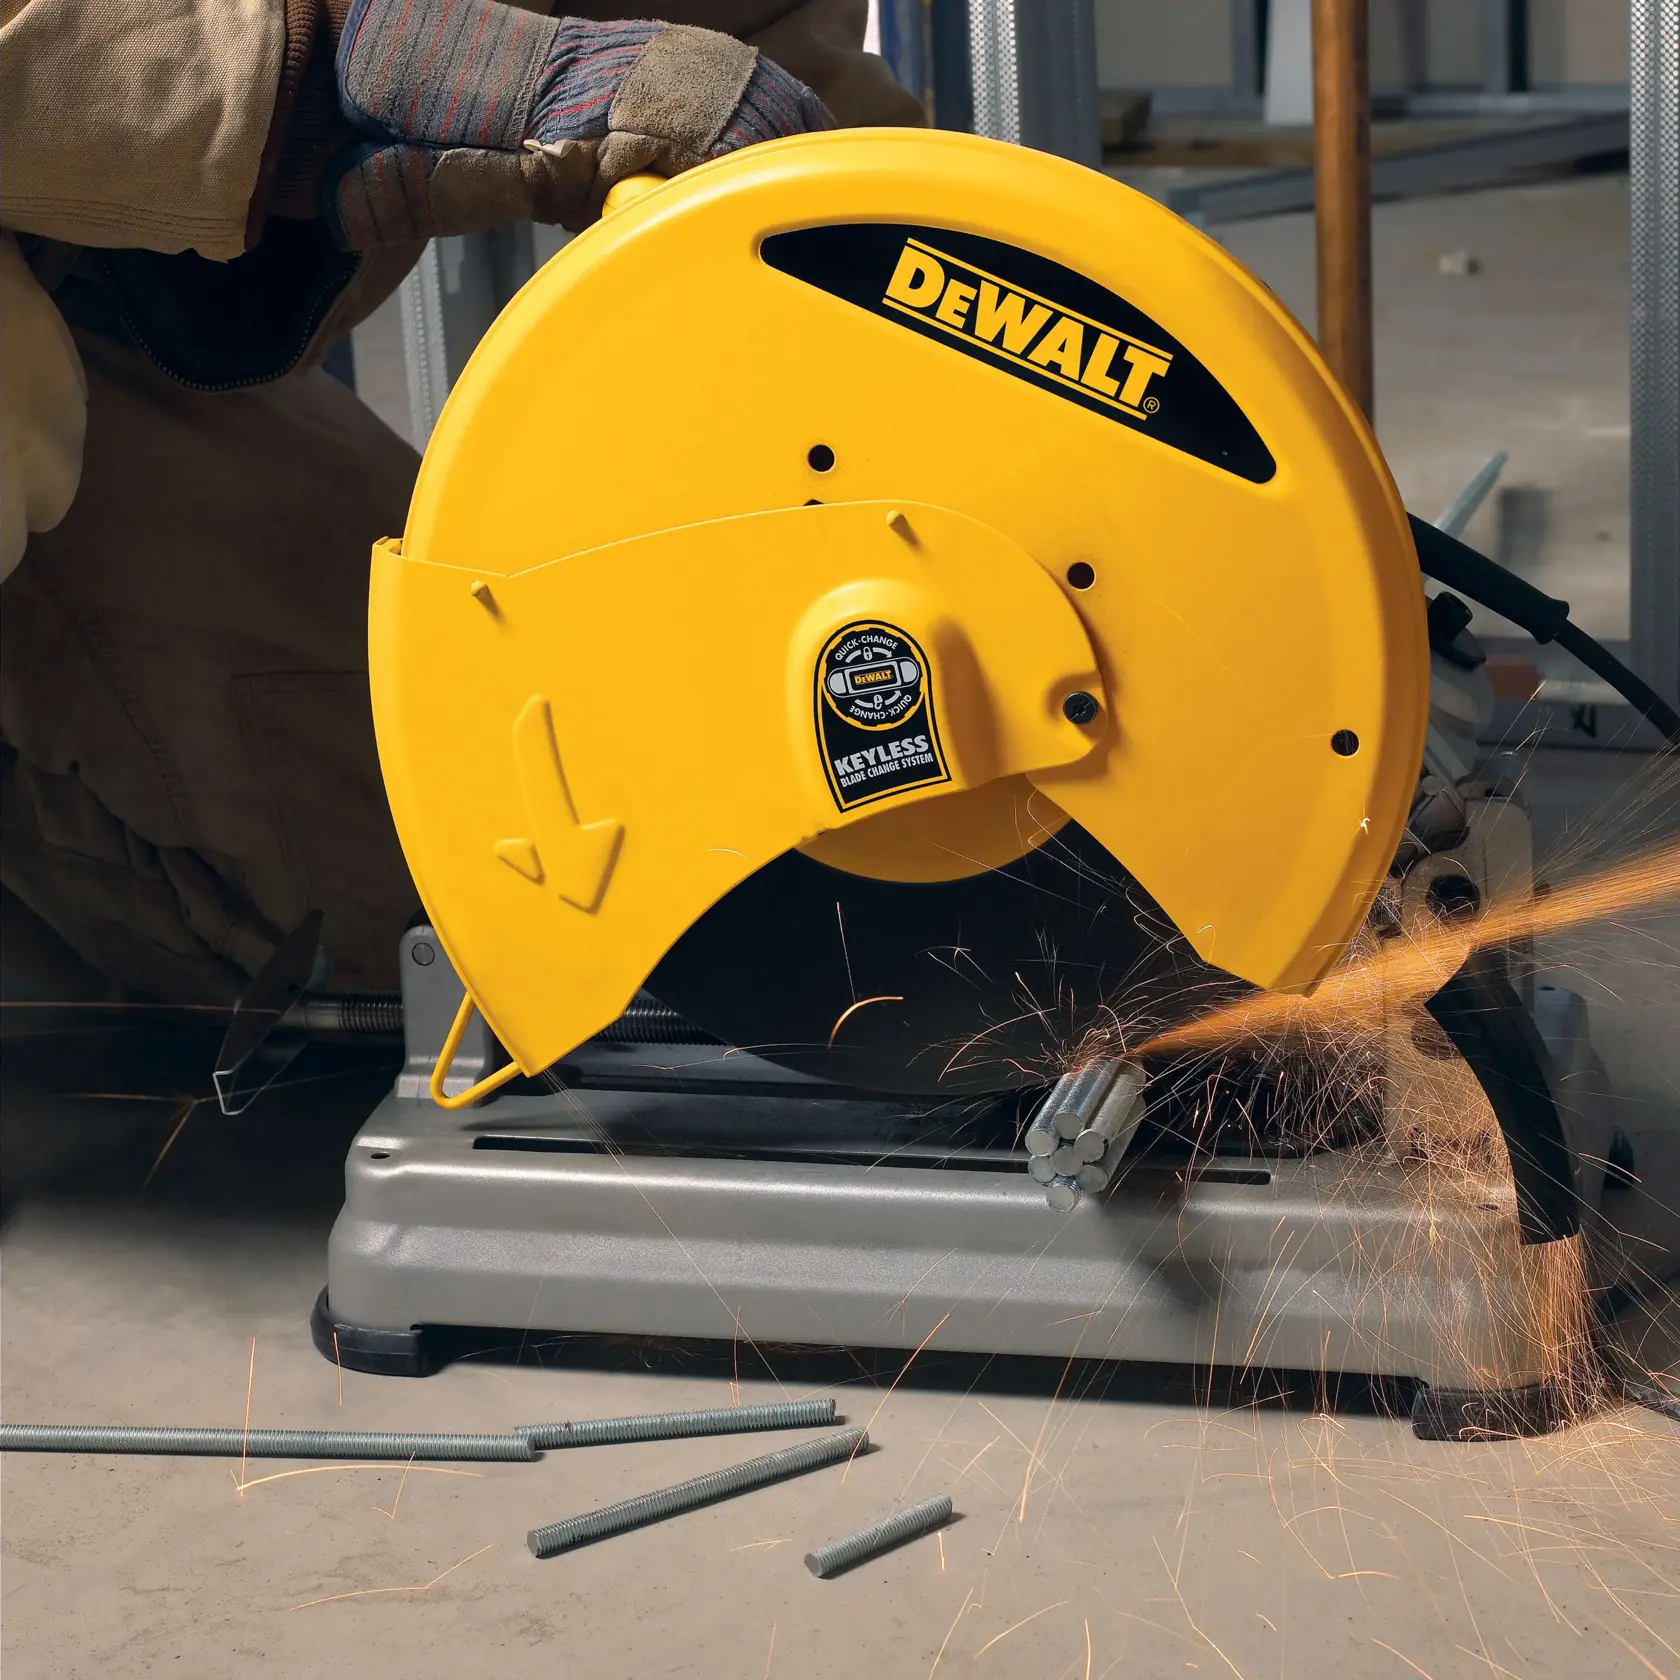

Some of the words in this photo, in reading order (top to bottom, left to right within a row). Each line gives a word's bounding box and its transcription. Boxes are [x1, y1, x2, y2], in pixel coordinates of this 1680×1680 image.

[834, 635, 899, 661] QUICK-CHANGE
[849, 694, 912, 720] QUICK-CHANGE
[834, 735, 929, 776] KEYLESS
[840, 771, 867, 788] BLADE
[867, 760, 901, 778] CHANGE
[902, 752, 934, 769] SYSTEM
